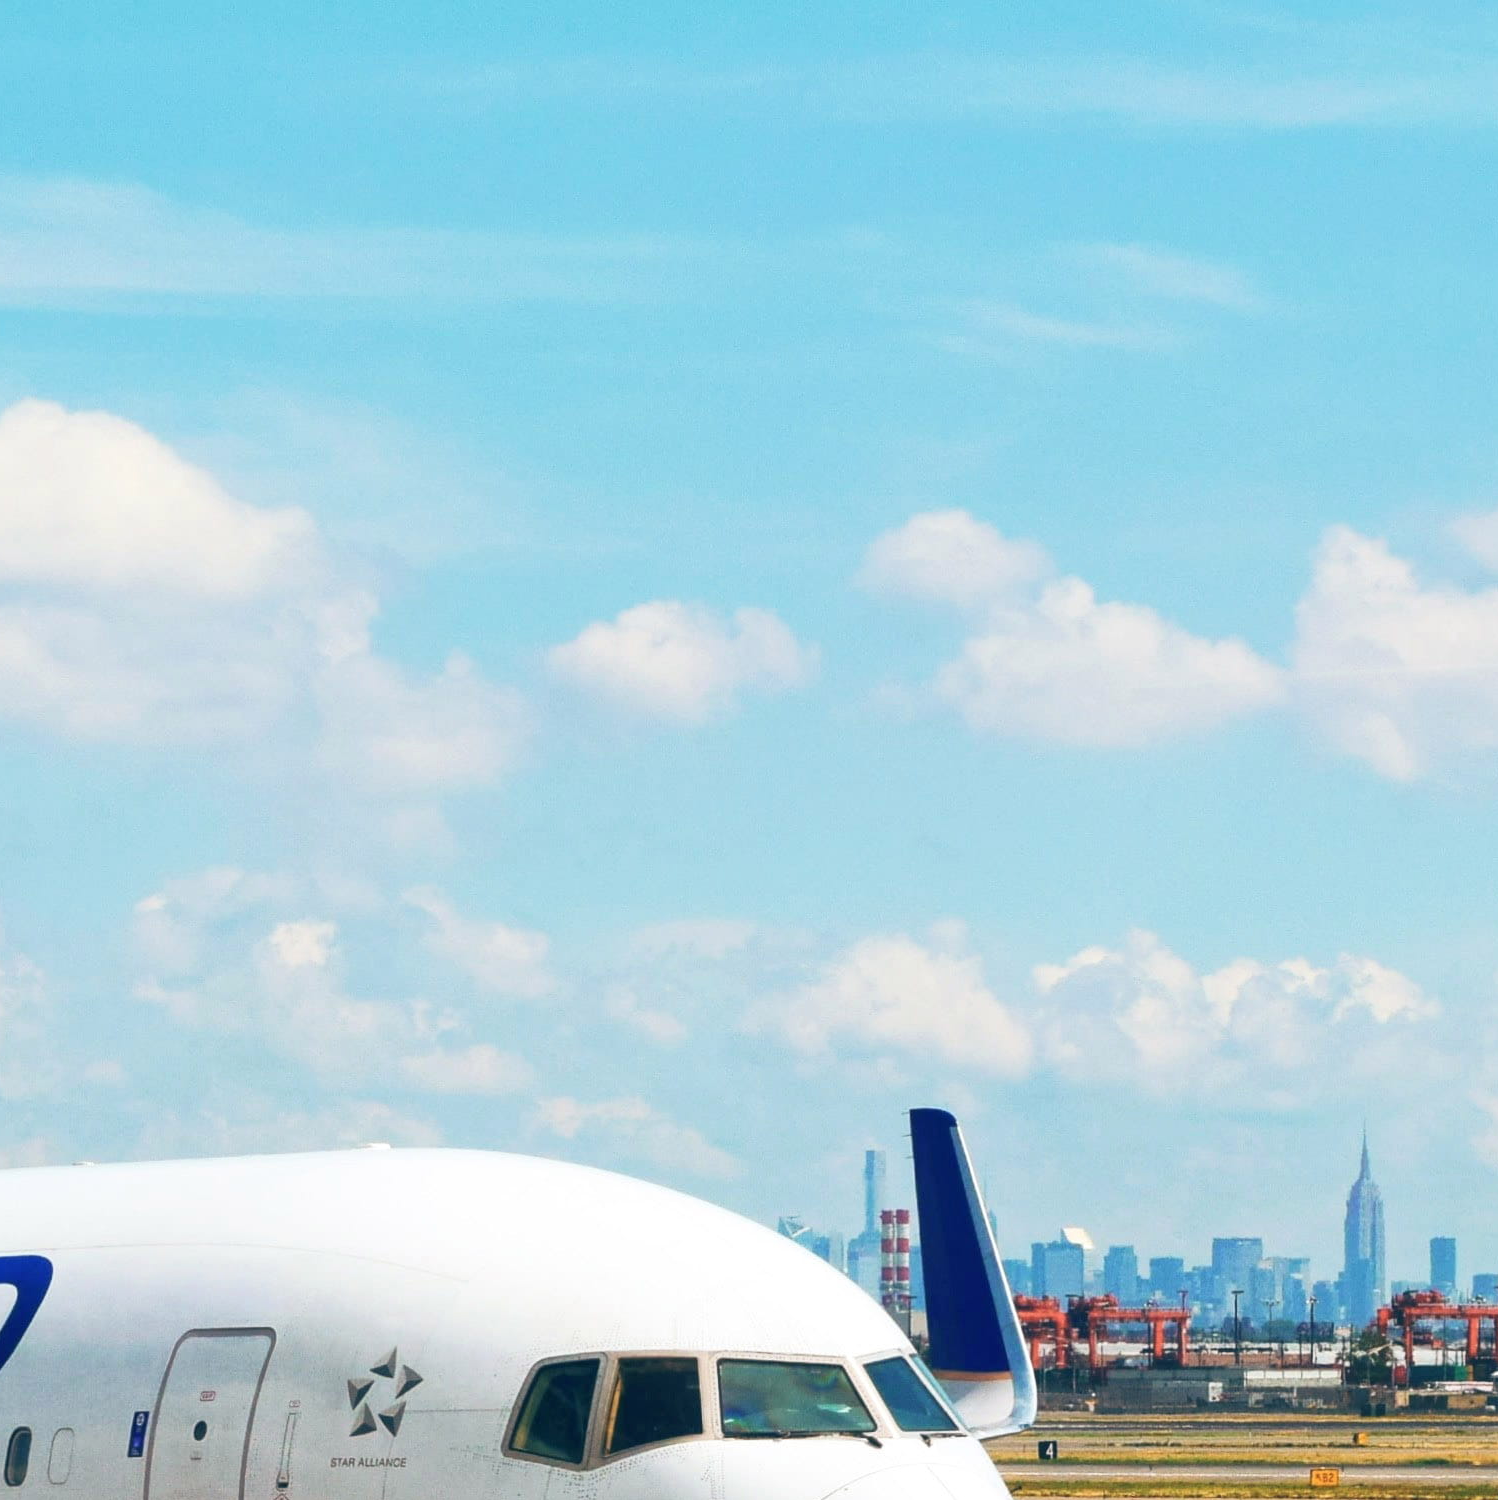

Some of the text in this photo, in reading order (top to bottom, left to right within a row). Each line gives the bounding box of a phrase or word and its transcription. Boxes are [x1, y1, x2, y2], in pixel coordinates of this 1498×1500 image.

[1045, 1442, 1055, 1457] 4
[330, 1457, 407, 1468] STAR ALLIANCE
